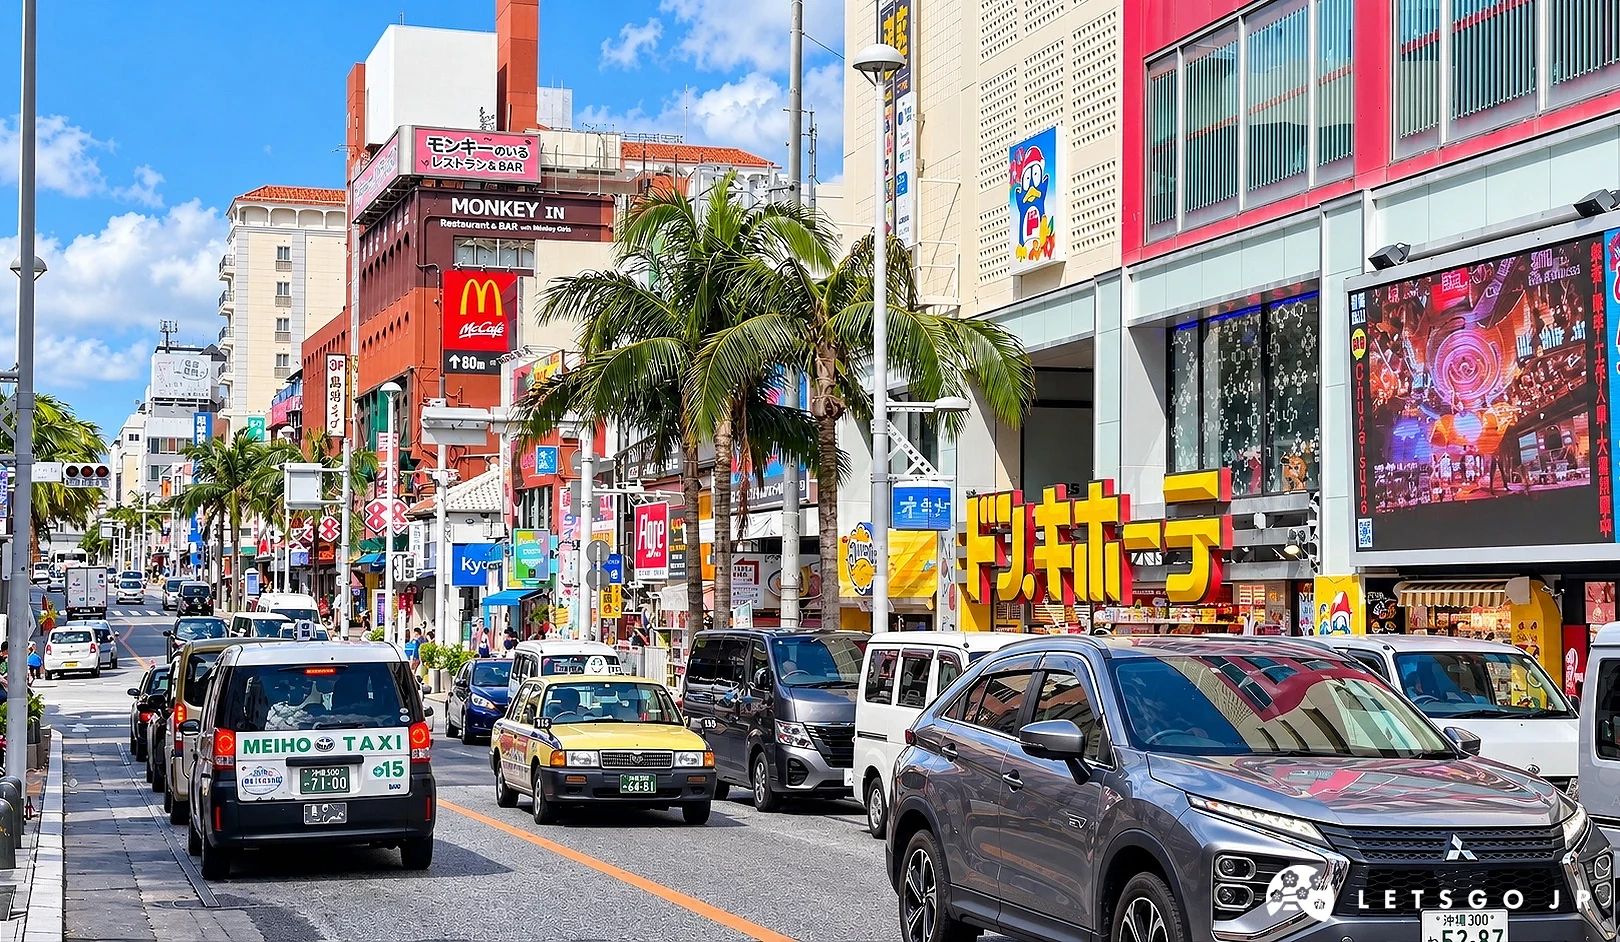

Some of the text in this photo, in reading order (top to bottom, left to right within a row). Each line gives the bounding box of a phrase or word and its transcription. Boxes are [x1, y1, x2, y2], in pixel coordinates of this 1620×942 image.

[426, 136, 530, 158] モンキーのいる
[451, 198, 565, 219] MONKEY IN
[440, 218, 490, 230] Restaurant
[498, 220, 518, 231] BAR
[459, 321, 505, 337] McCafé
[243, 735, 402, 754] MEIHO TAXI
[382, 761, 404, 778] 15
[1468, 913, 1489, 926] 300
